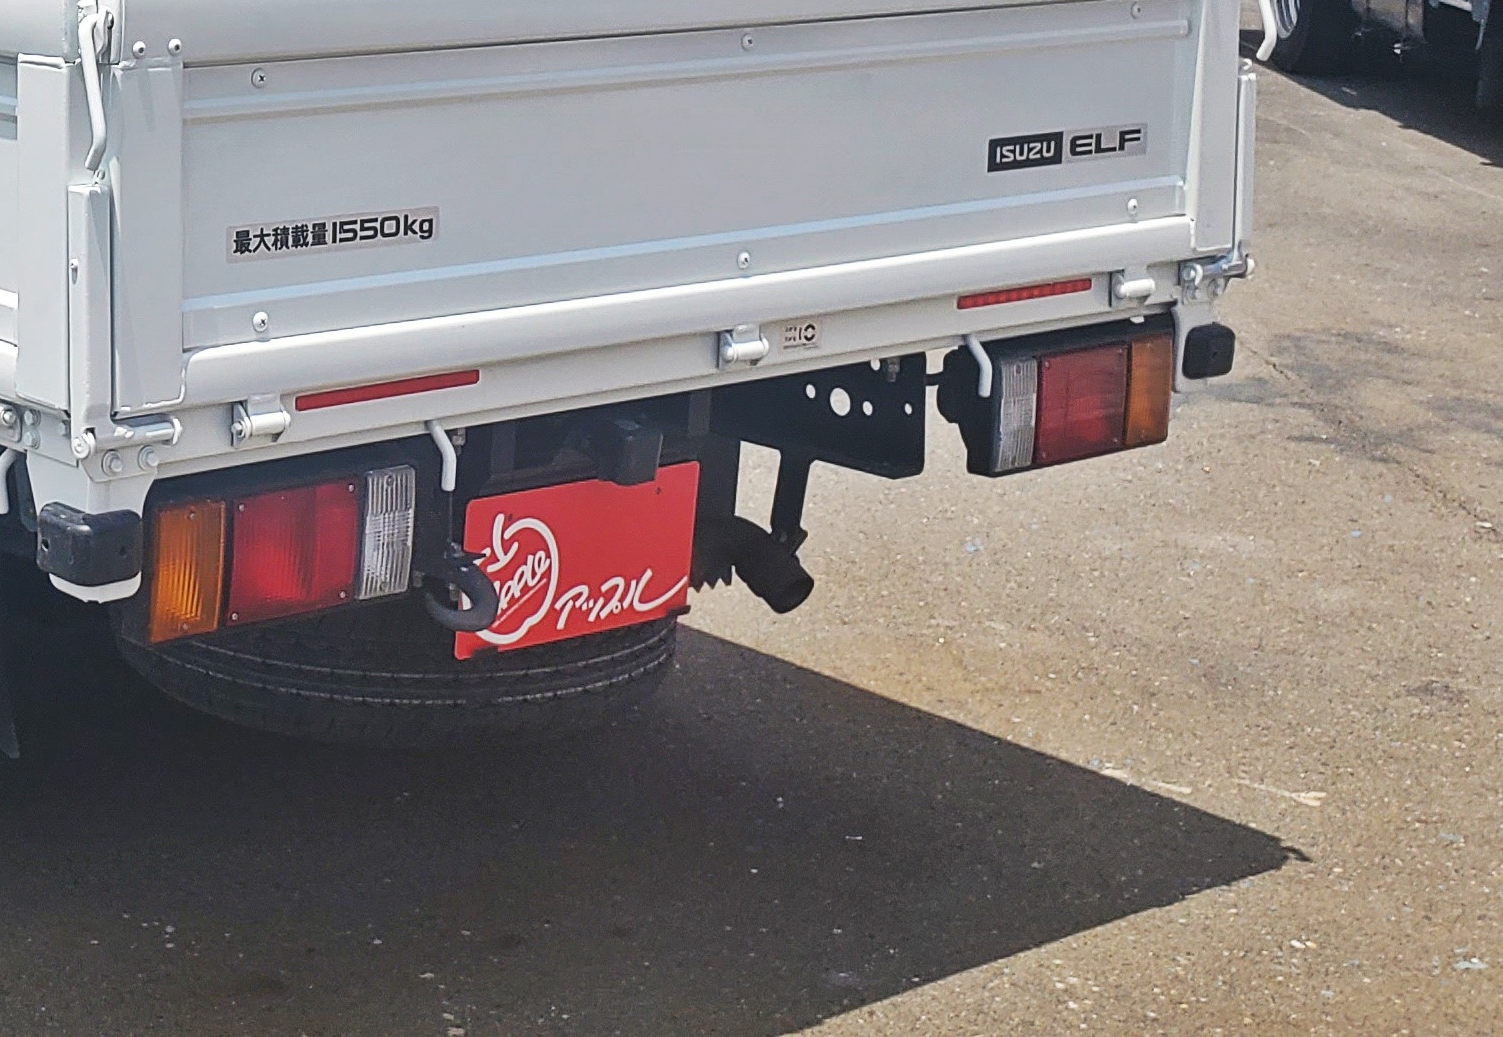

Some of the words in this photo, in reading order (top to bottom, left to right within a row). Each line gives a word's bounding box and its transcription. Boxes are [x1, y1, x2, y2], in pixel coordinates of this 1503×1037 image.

[996, 140, 1055, 164] ISUZU
[1069, 128, 1142, 157] ELF
[554, 567, 688, 630] アップル
